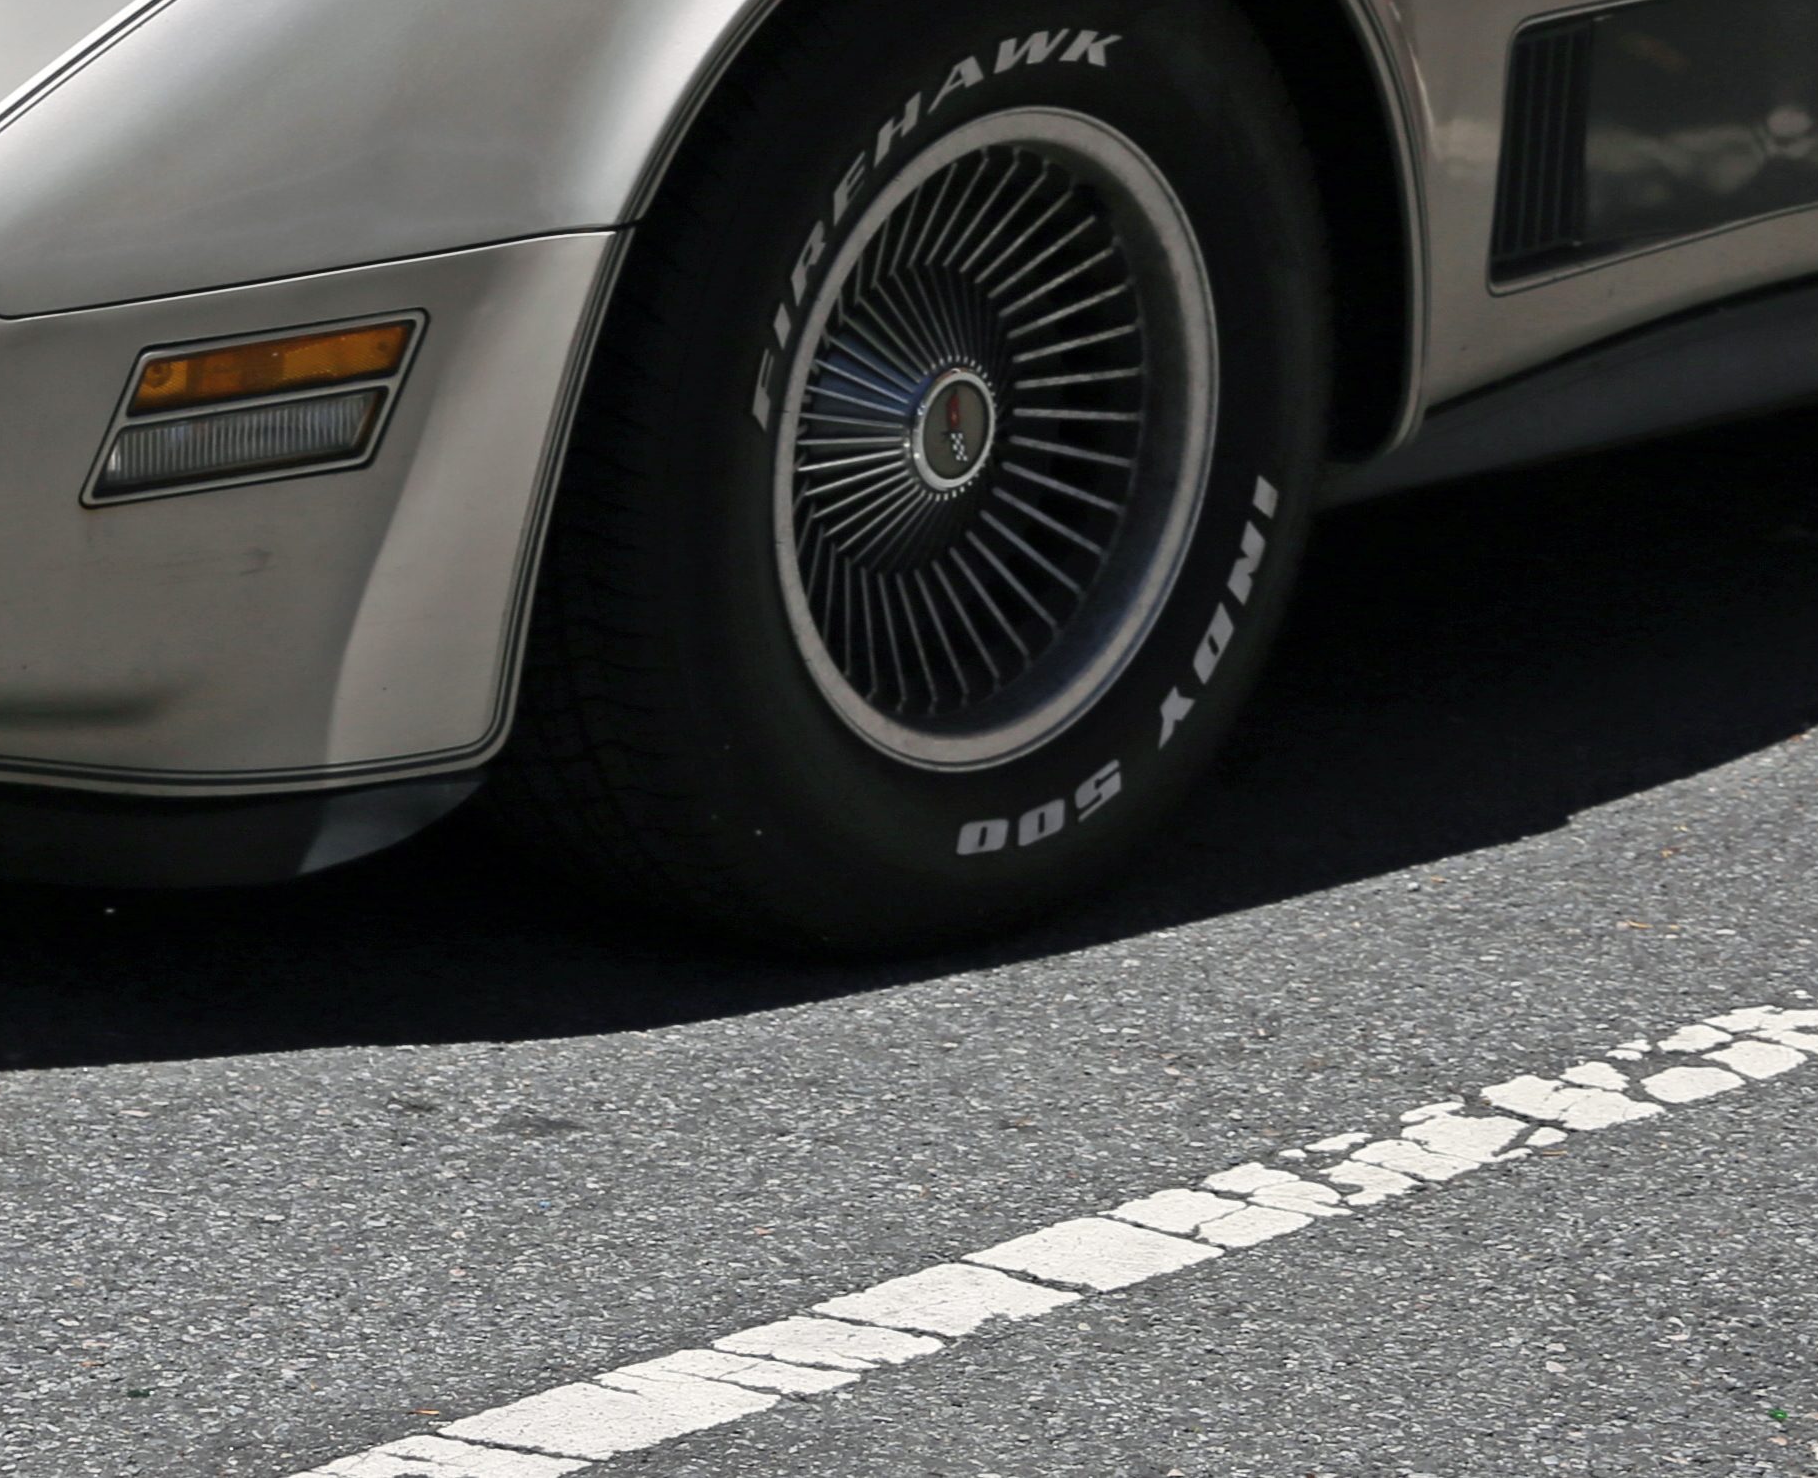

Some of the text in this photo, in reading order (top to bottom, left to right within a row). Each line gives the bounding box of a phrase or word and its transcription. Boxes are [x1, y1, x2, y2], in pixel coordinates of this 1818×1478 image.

[750, 28, 1125, 433] FIREHAWK
[955, 474, 1280, 858] INDY 500
